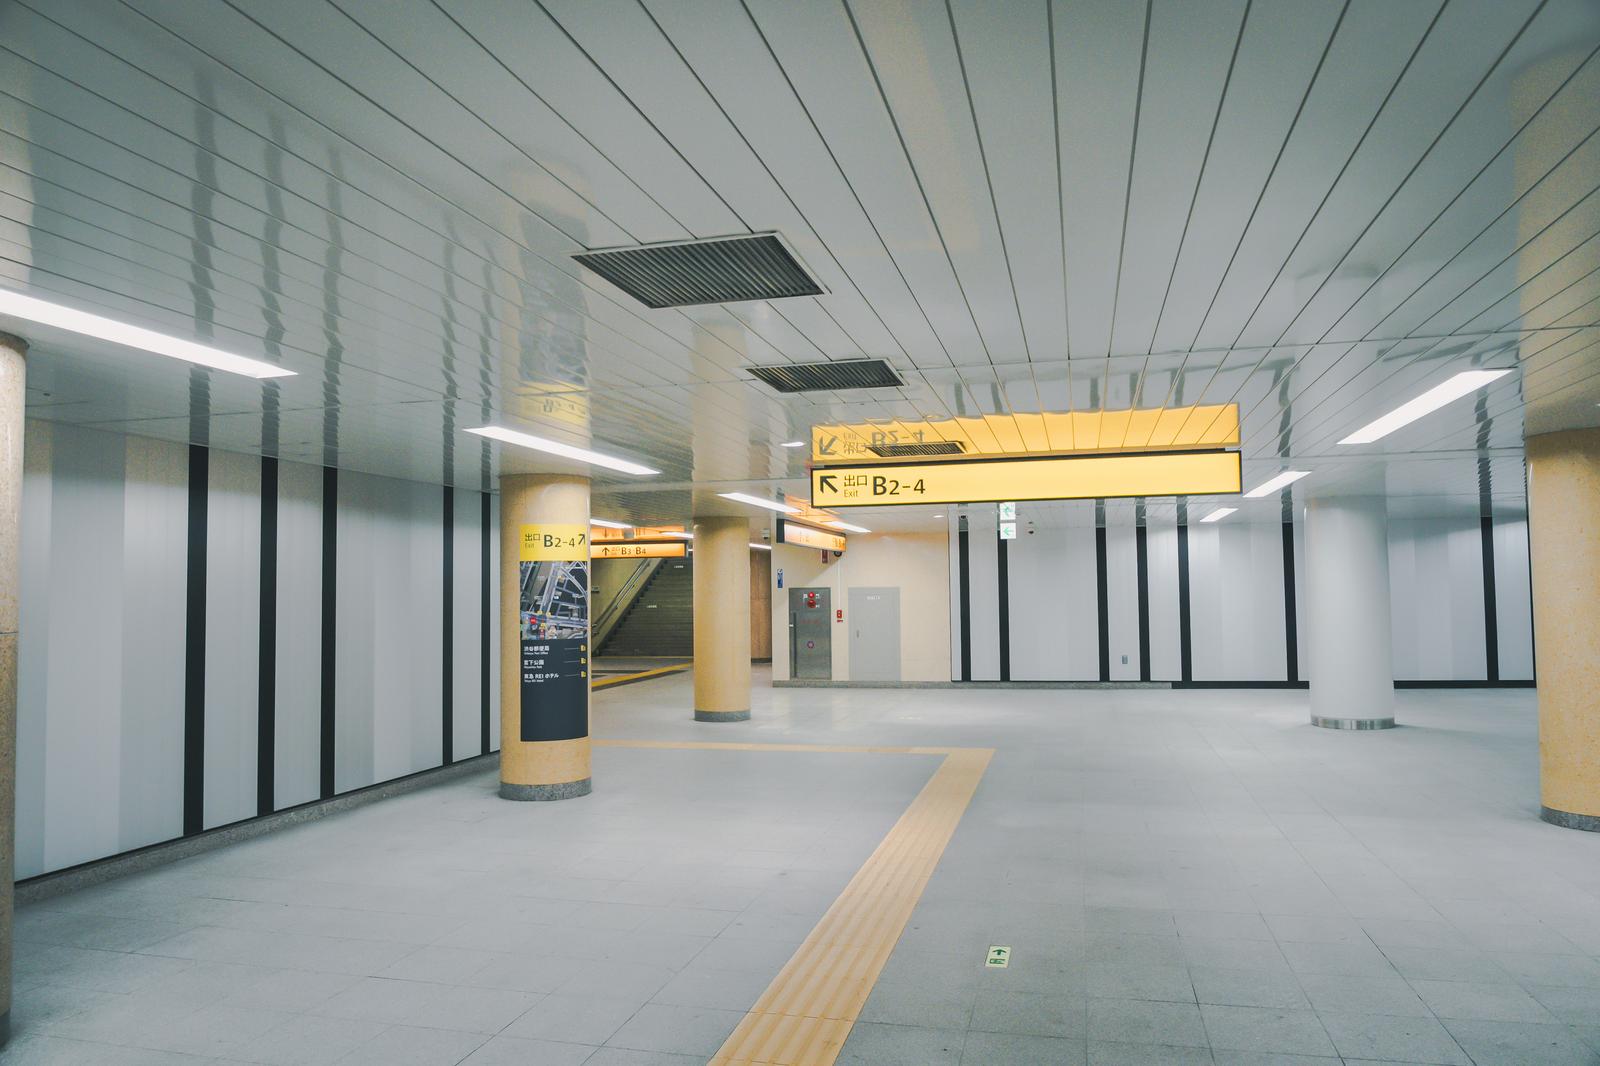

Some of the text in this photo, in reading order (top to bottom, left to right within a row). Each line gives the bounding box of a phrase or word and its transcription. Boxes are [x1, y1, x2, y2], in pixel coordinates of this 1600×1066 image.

[843, 474, 868, 487] 出口
[872, 475, 926, 496] B2-4
[843, 489, 859, 498] Exit
[524, 532, 541, 541] 出口
[543, 534, 575, 548] B2-4
